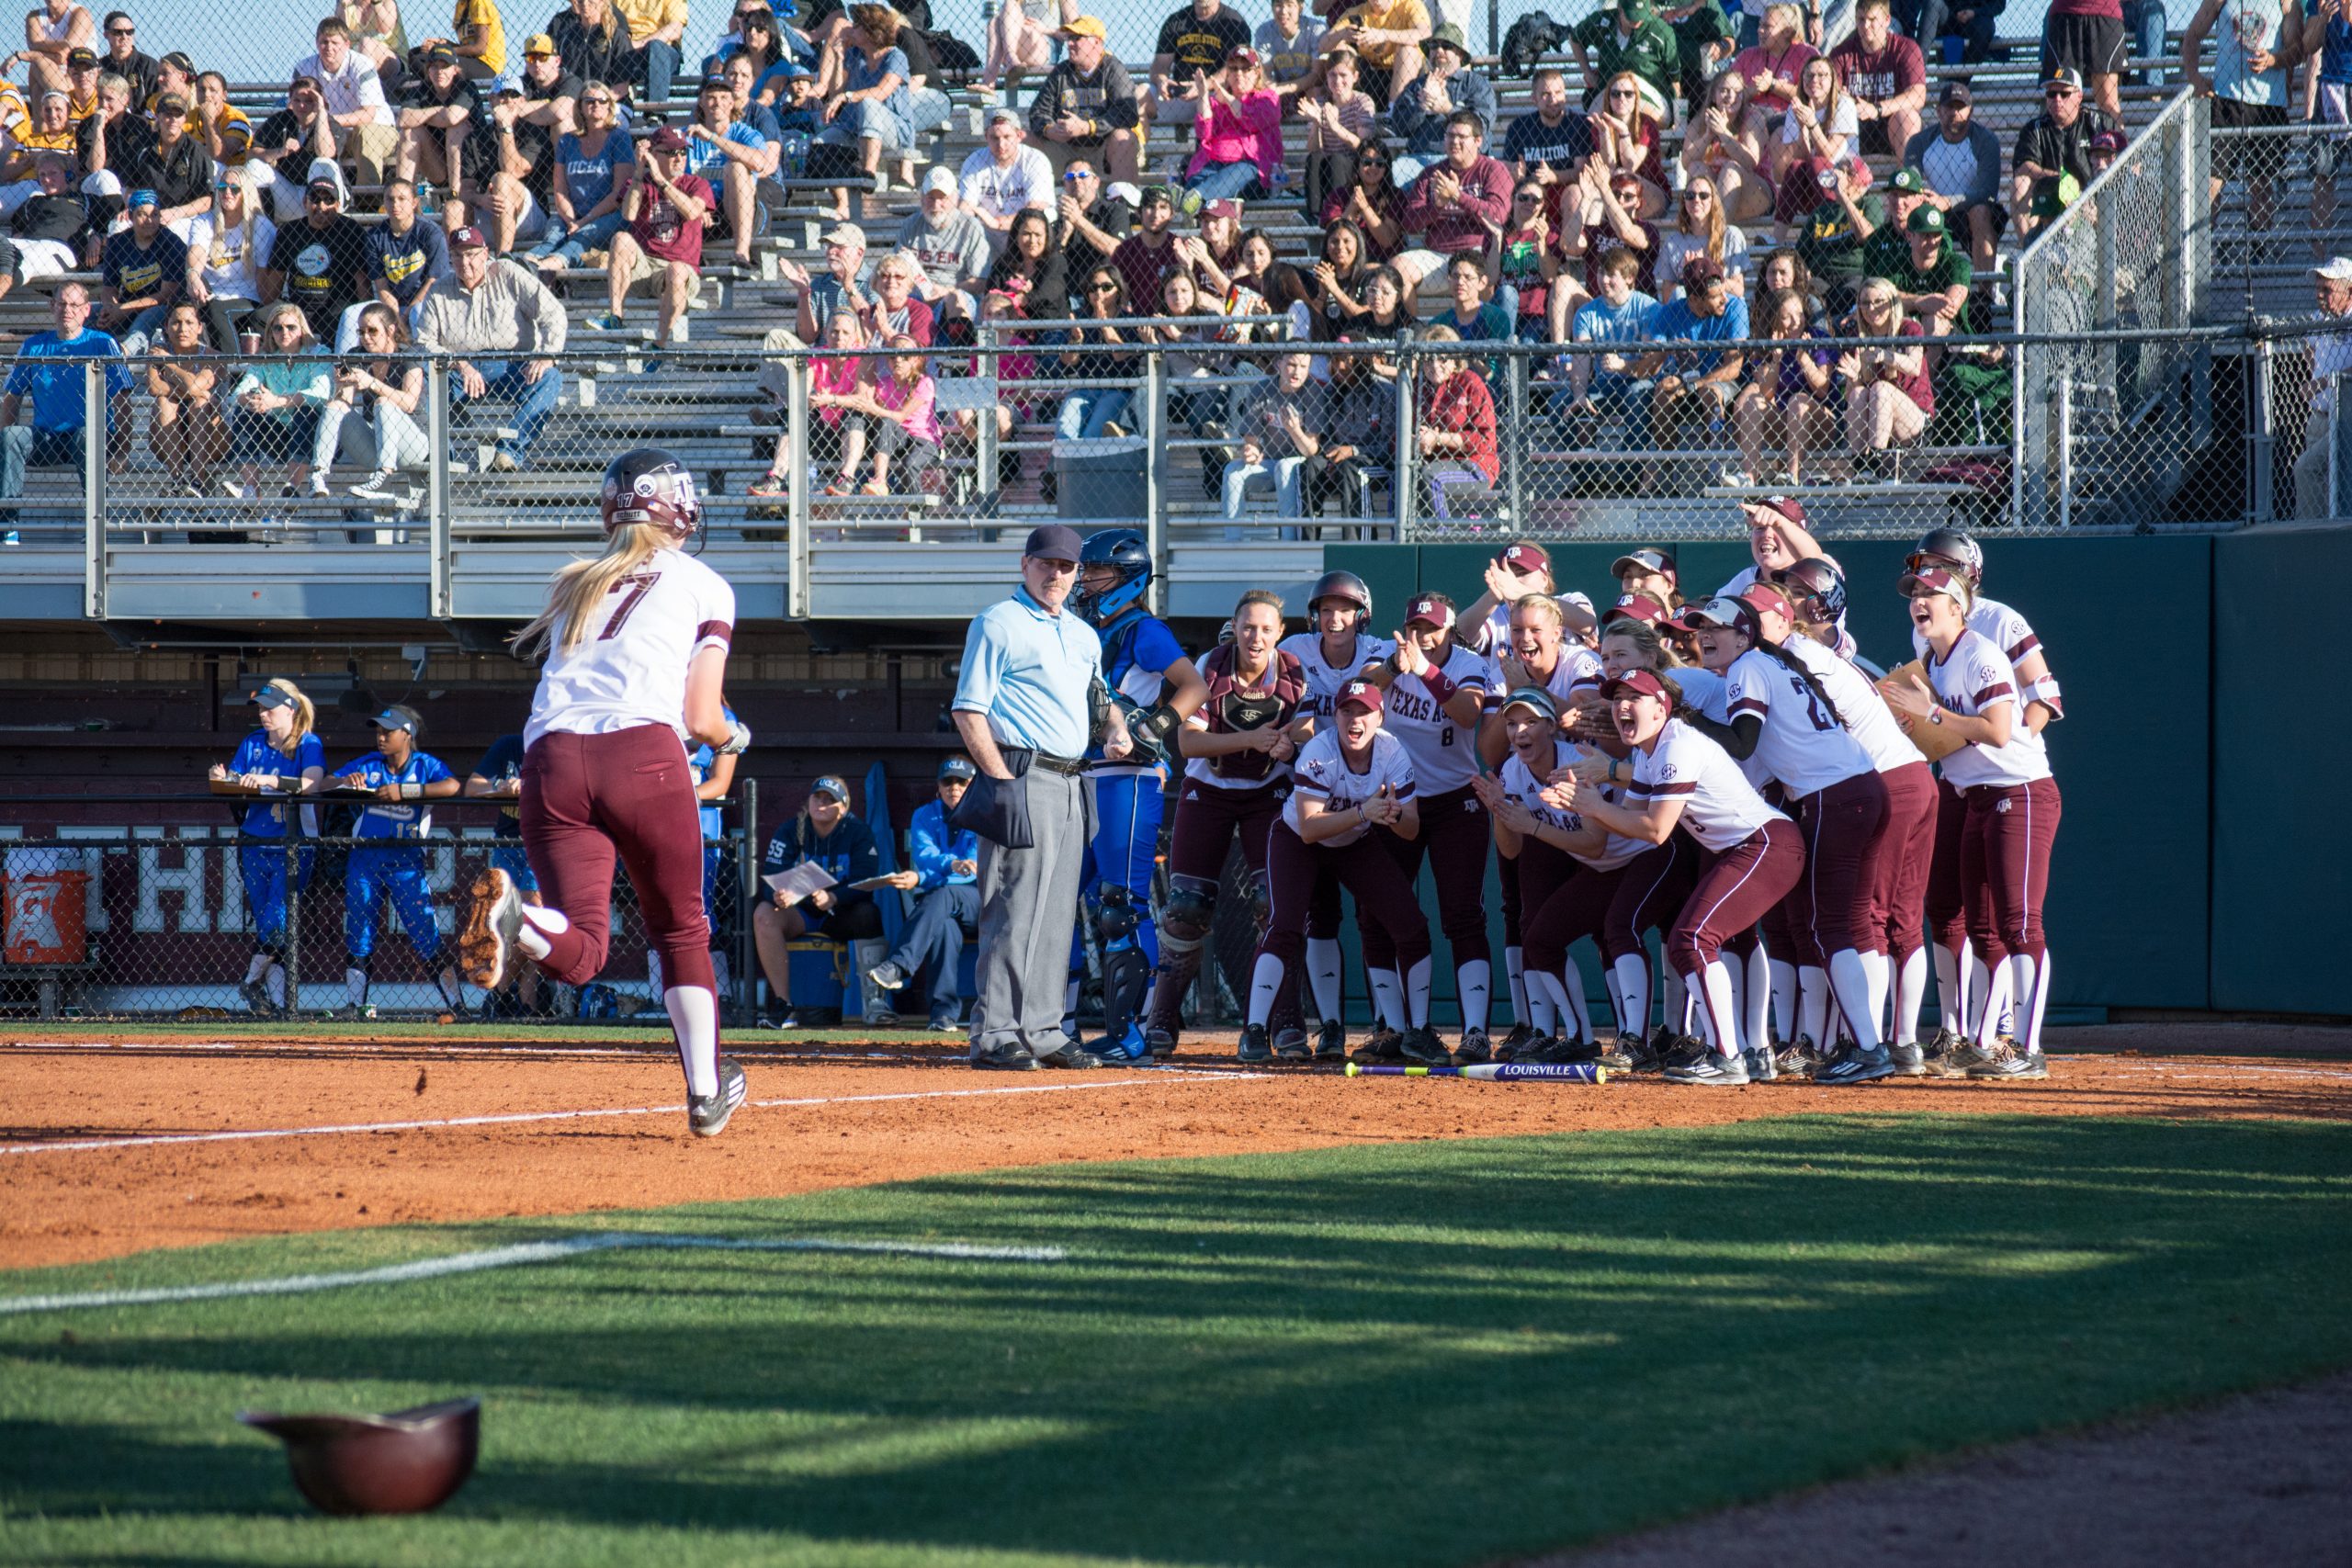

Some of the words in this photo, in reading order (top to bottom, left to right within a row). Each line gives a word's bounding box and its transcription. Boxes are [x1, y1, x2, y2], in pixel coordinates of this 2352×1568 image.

[1524, 143, 1569, 162] WALTON
[567, 159, 610, 177] UCLA
[617, 492, 633, 508] 17
[616, 509, 641, 520] schutt
[576, 572, 662, 642] 7
[1981, 666, 1996, 682] SEC
[1242, 691, 1266, 700] AGGIES
[1389, 684, 1430, 722] TEXAS
[1431, 707, 1453, 724] A&
[1940, 694, 1963, 716] &M
[1441, 727, 1454, 747] 8
[1661, 763, 1678, 780] SEC
[819, 779, 841, 793] UCLA
[767, 838, 786, 859] 55
[1504, 1064, 1571, 1077] LOUISVILLE
